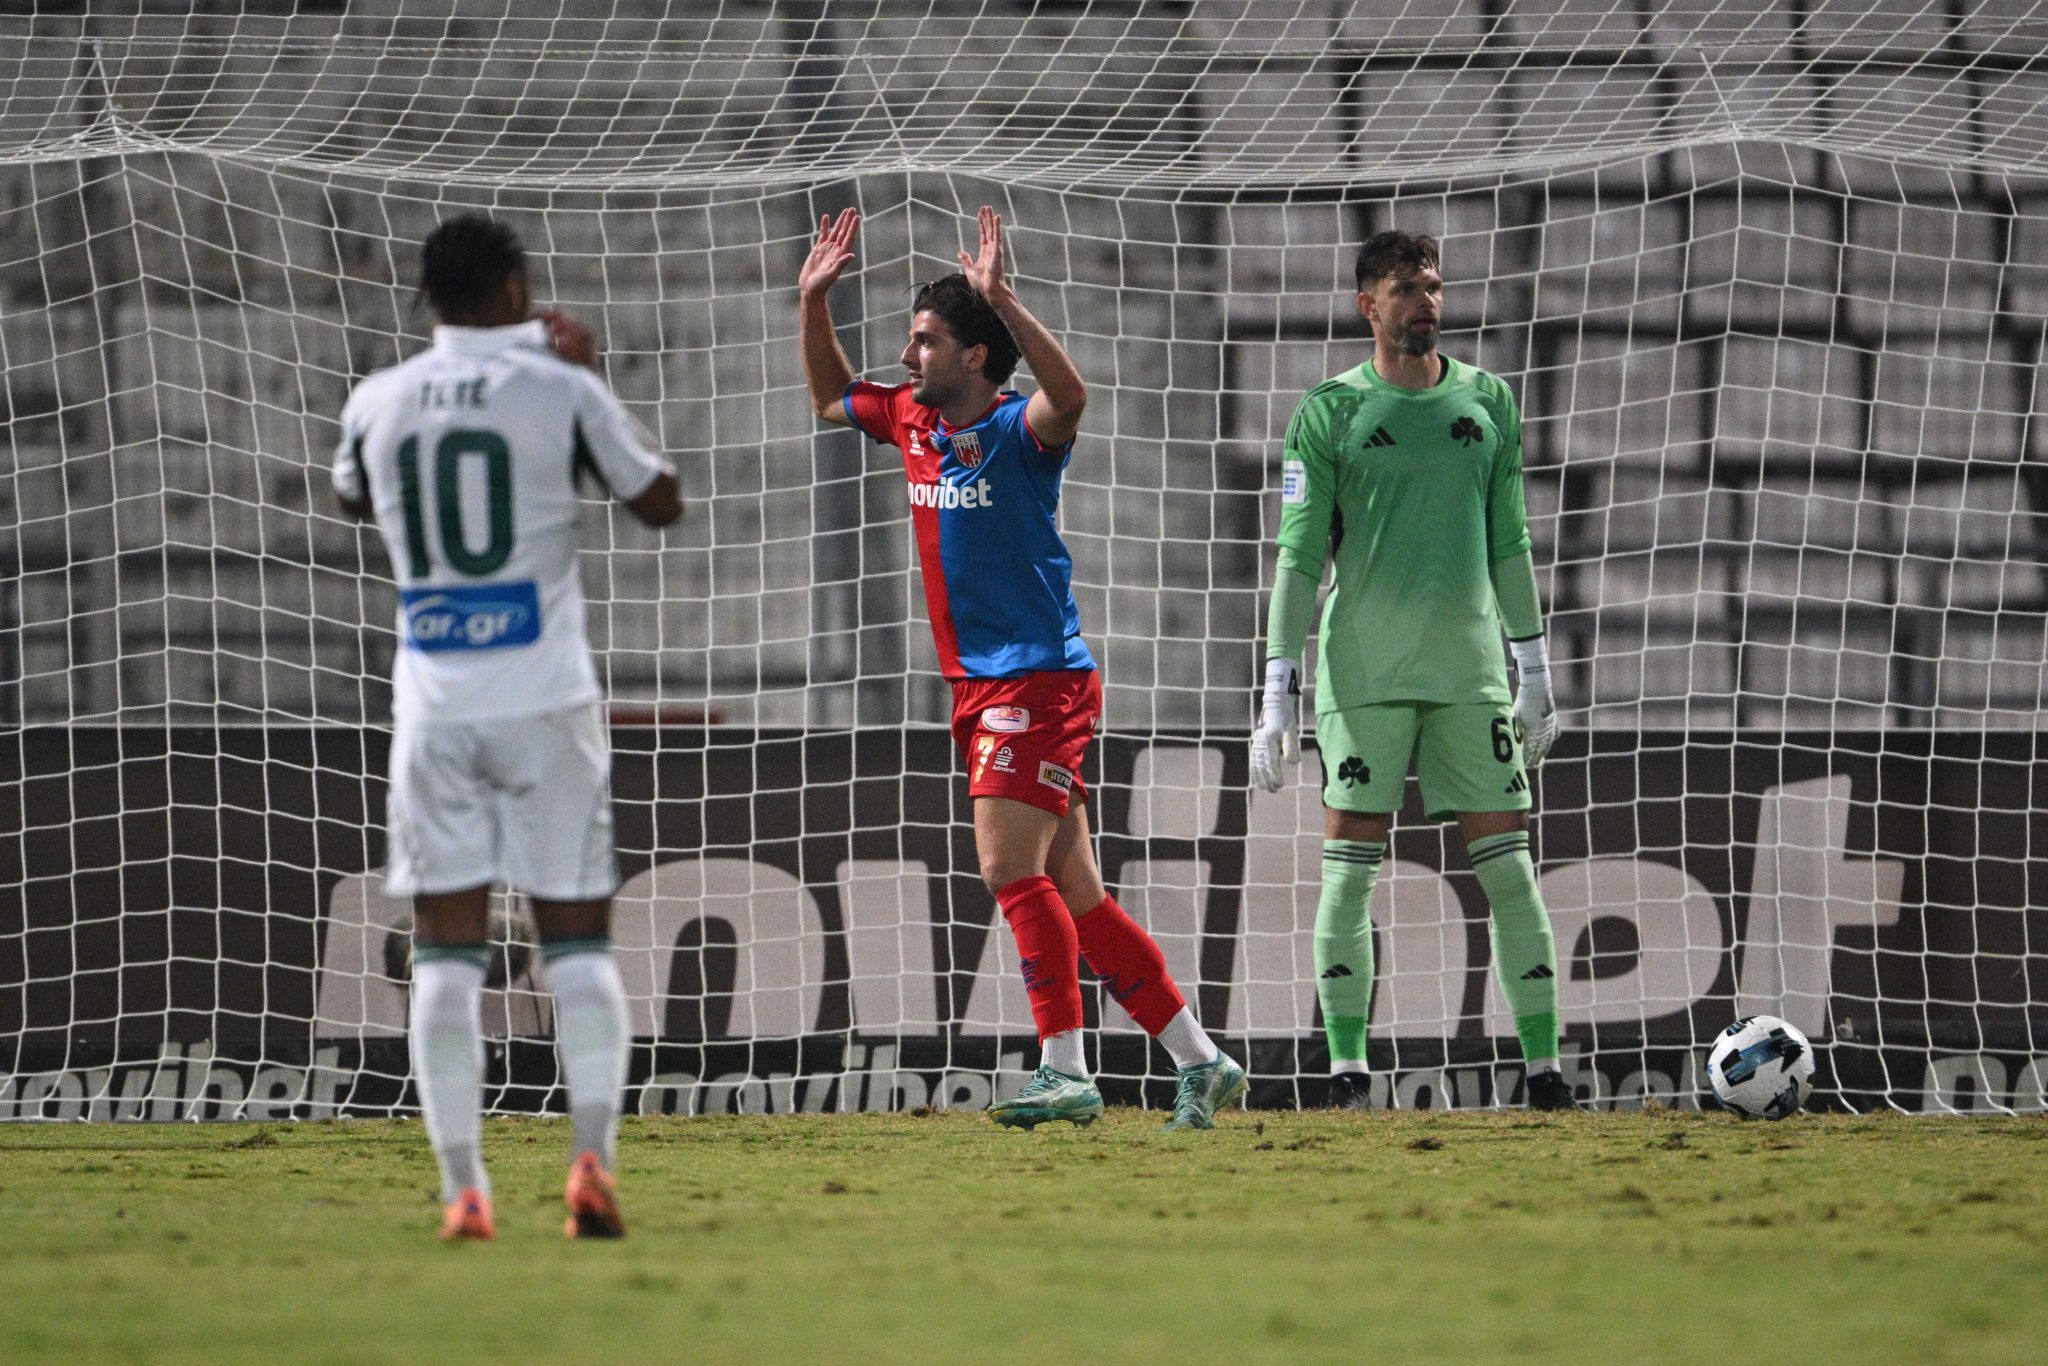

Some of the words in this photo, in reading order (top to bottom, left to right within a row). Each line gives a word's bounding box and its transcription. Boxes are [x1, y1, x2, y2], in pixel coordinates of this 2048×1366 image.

[397, 429, 516, 578] 10
[974, 735, 995, 783] 7
[0, 1040, 351, 1120] ovibet
